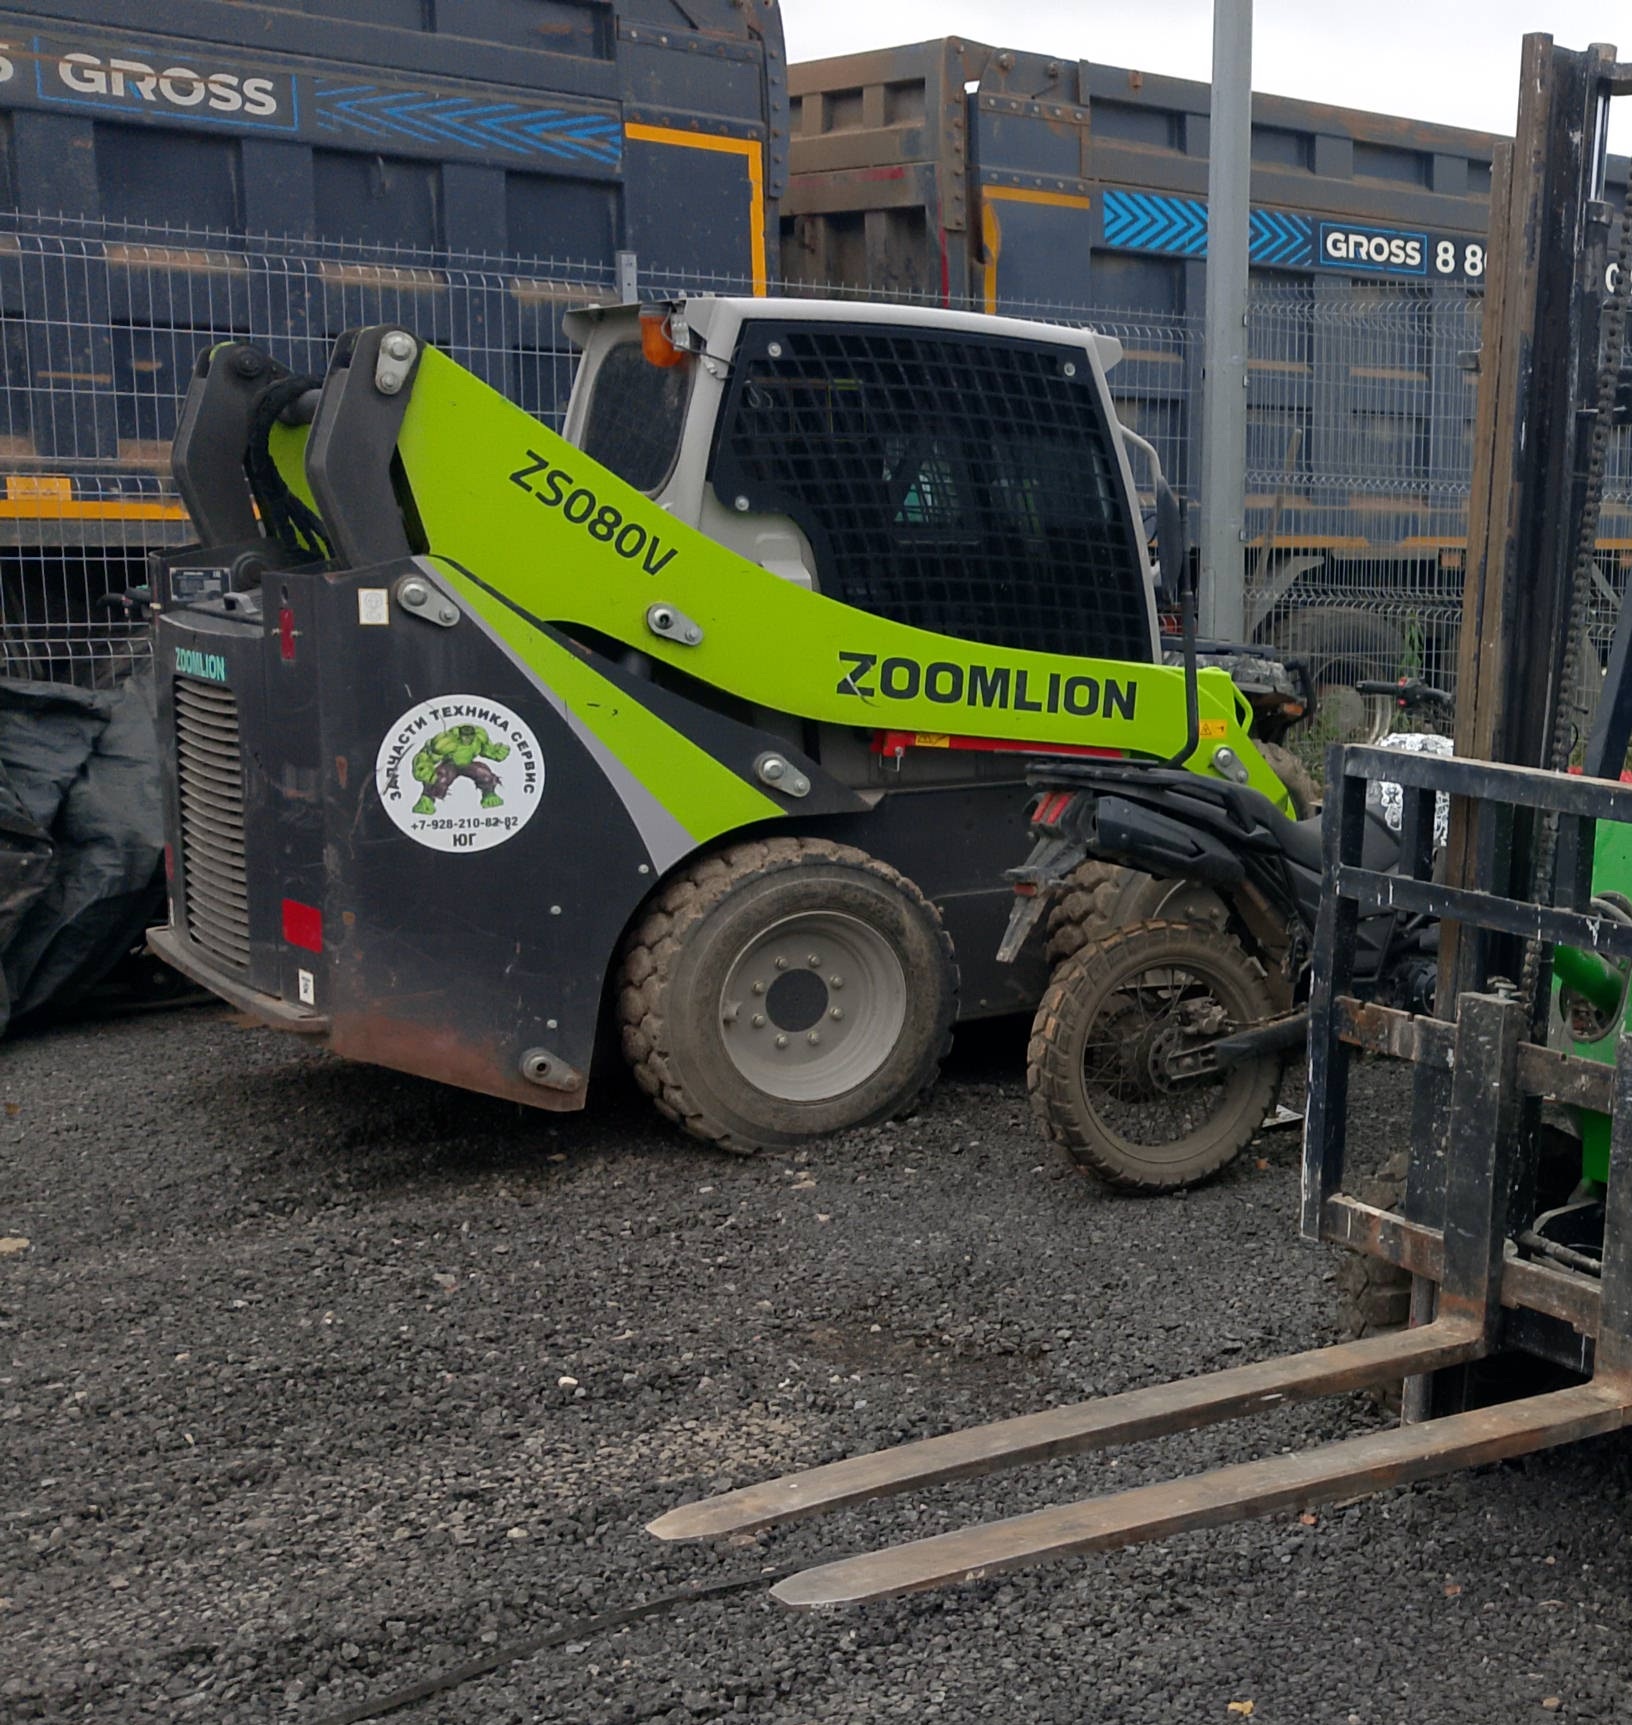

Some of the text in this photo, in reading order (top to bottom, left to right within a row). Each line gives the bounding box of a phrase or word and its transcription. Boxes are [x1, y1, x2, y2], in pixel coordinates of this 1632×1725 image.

[58, 52, 277, 116] GROSS
[1326, 232, 1421, 266] GROSS
[1435, 240, 1455, 274] 8
[509, 449, 678, 576] ZS080V
[175, 647, 225, 681] ZOOMLION
[837, 651, 1137, 720] ZOOMLION
[386, 705, 536, 800] ЗАПЧАСТИ ТЕХНИКА СЕРВИС
[453, 833, 477, 847] ЮГ
